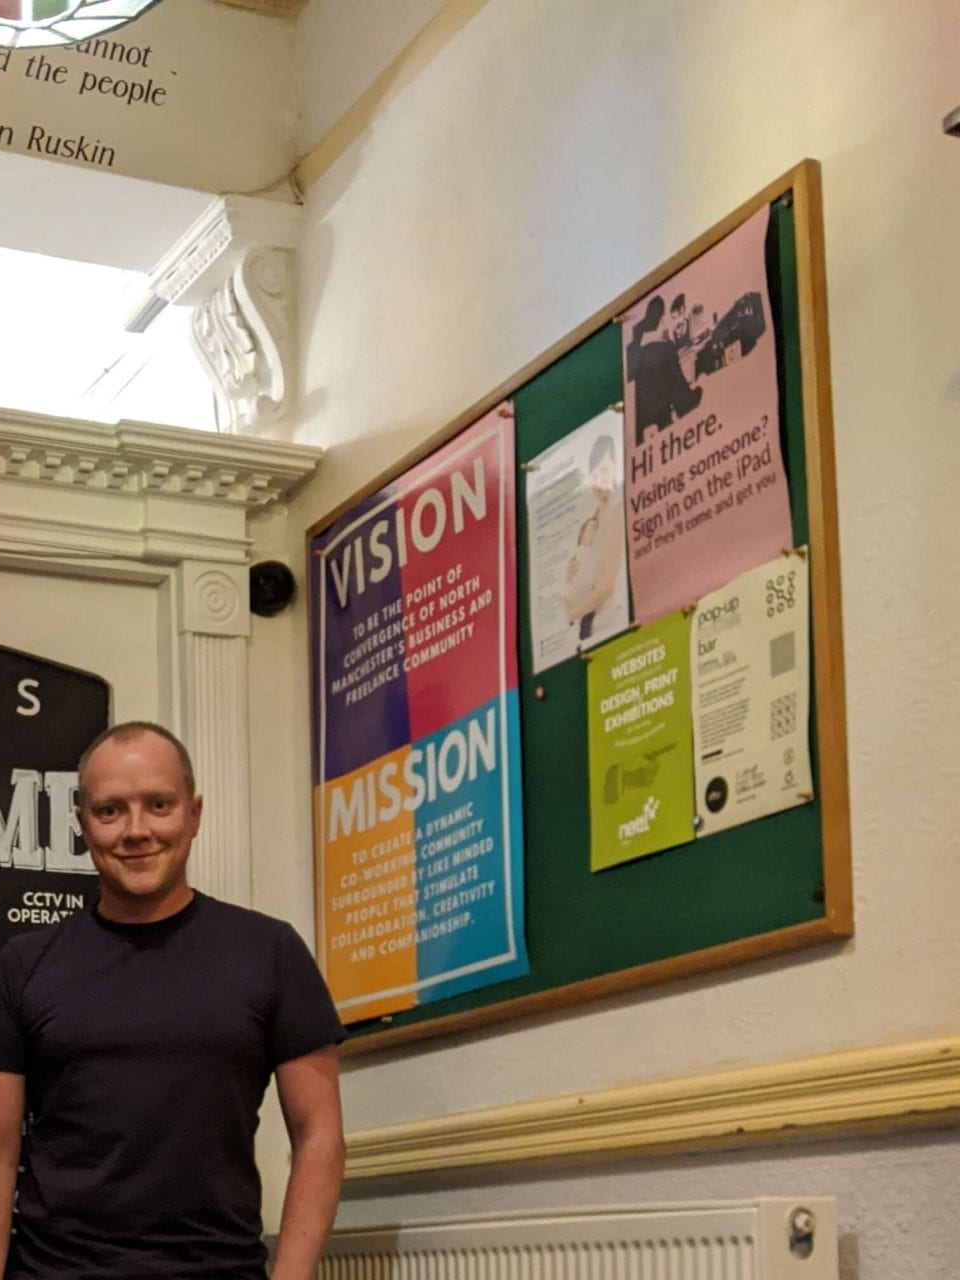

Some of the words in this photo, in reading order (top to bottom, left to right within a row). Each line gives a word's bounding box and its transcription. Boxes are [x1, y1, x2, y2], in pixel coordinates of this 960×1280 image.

[24, 54, 69, 85] the
[78, 70, 167, 107] people
[26, 125, 116, 167] Ruskin
[630, 472, 686, 515] Visiting
[689, 415, 769, 480] someone?
[631, 433, 653, 484] Hi
[659, 413, 723, 466] there.
[632, 513, 663, 542] Sign
[666, 500, 680, 522] in
[683, 488, 703, 511] on
[706, 471, 733, 497] the
[737, 442, 772, 480] iPad
[685, 508, 714, 532] come
[755, 472, 777, 494] you
[330, 457, 487, 609] VISION
[343, 611, 415, 668] CONVERGENCE
[419, 601, 435, 621] OF
[439, 576, 480, 610] NORTH
[353, 623, 366, 640] TO
[367, 615, 380, 631] BE
[382, 601, 402, 624] THE
[406, 575, 442, 607] POINT
[447, 564, 462, 585] OF
[331, 640, 404, 694] MANCHESTER'S
[408, 605, 466, 647] BUSINESS
[470, 590, 492, 616] AND
[346, 664, 399, 706] FREELANCE
[403, 622, 474, 672] COMMUNITY
[611, 644, 666, 680] WEBSITES
[644, 668, 678, 695] PRINT
[328, 708, 496, 843] MISSION
[340, 852, 417, 888] CO-WORKING
[421, 819, 484, 861] COMMUNITY
[352, 849, 367, 867] TO
[371, 831, 412, 859] CREATE
[416, 827, 423, 842] A
[426, 802, 474, 837] DYNAMIC
[22, 891, 64, 908] CCTV
[65, 893, 84, 910] IN
[331, 874, 407, 912] SURROUNDED
[428, 857, 449, 880] LIKE
[452, 837, 493, 867] MINDED
[345, 903, 388, 926] PEOPLE
[393, 889, 419, 911] THAT
[423, 864, 479, 900] STIMULATE
[433, 881, 496, 920] CREATIVITY
[350, 943, 375, 963] AND
